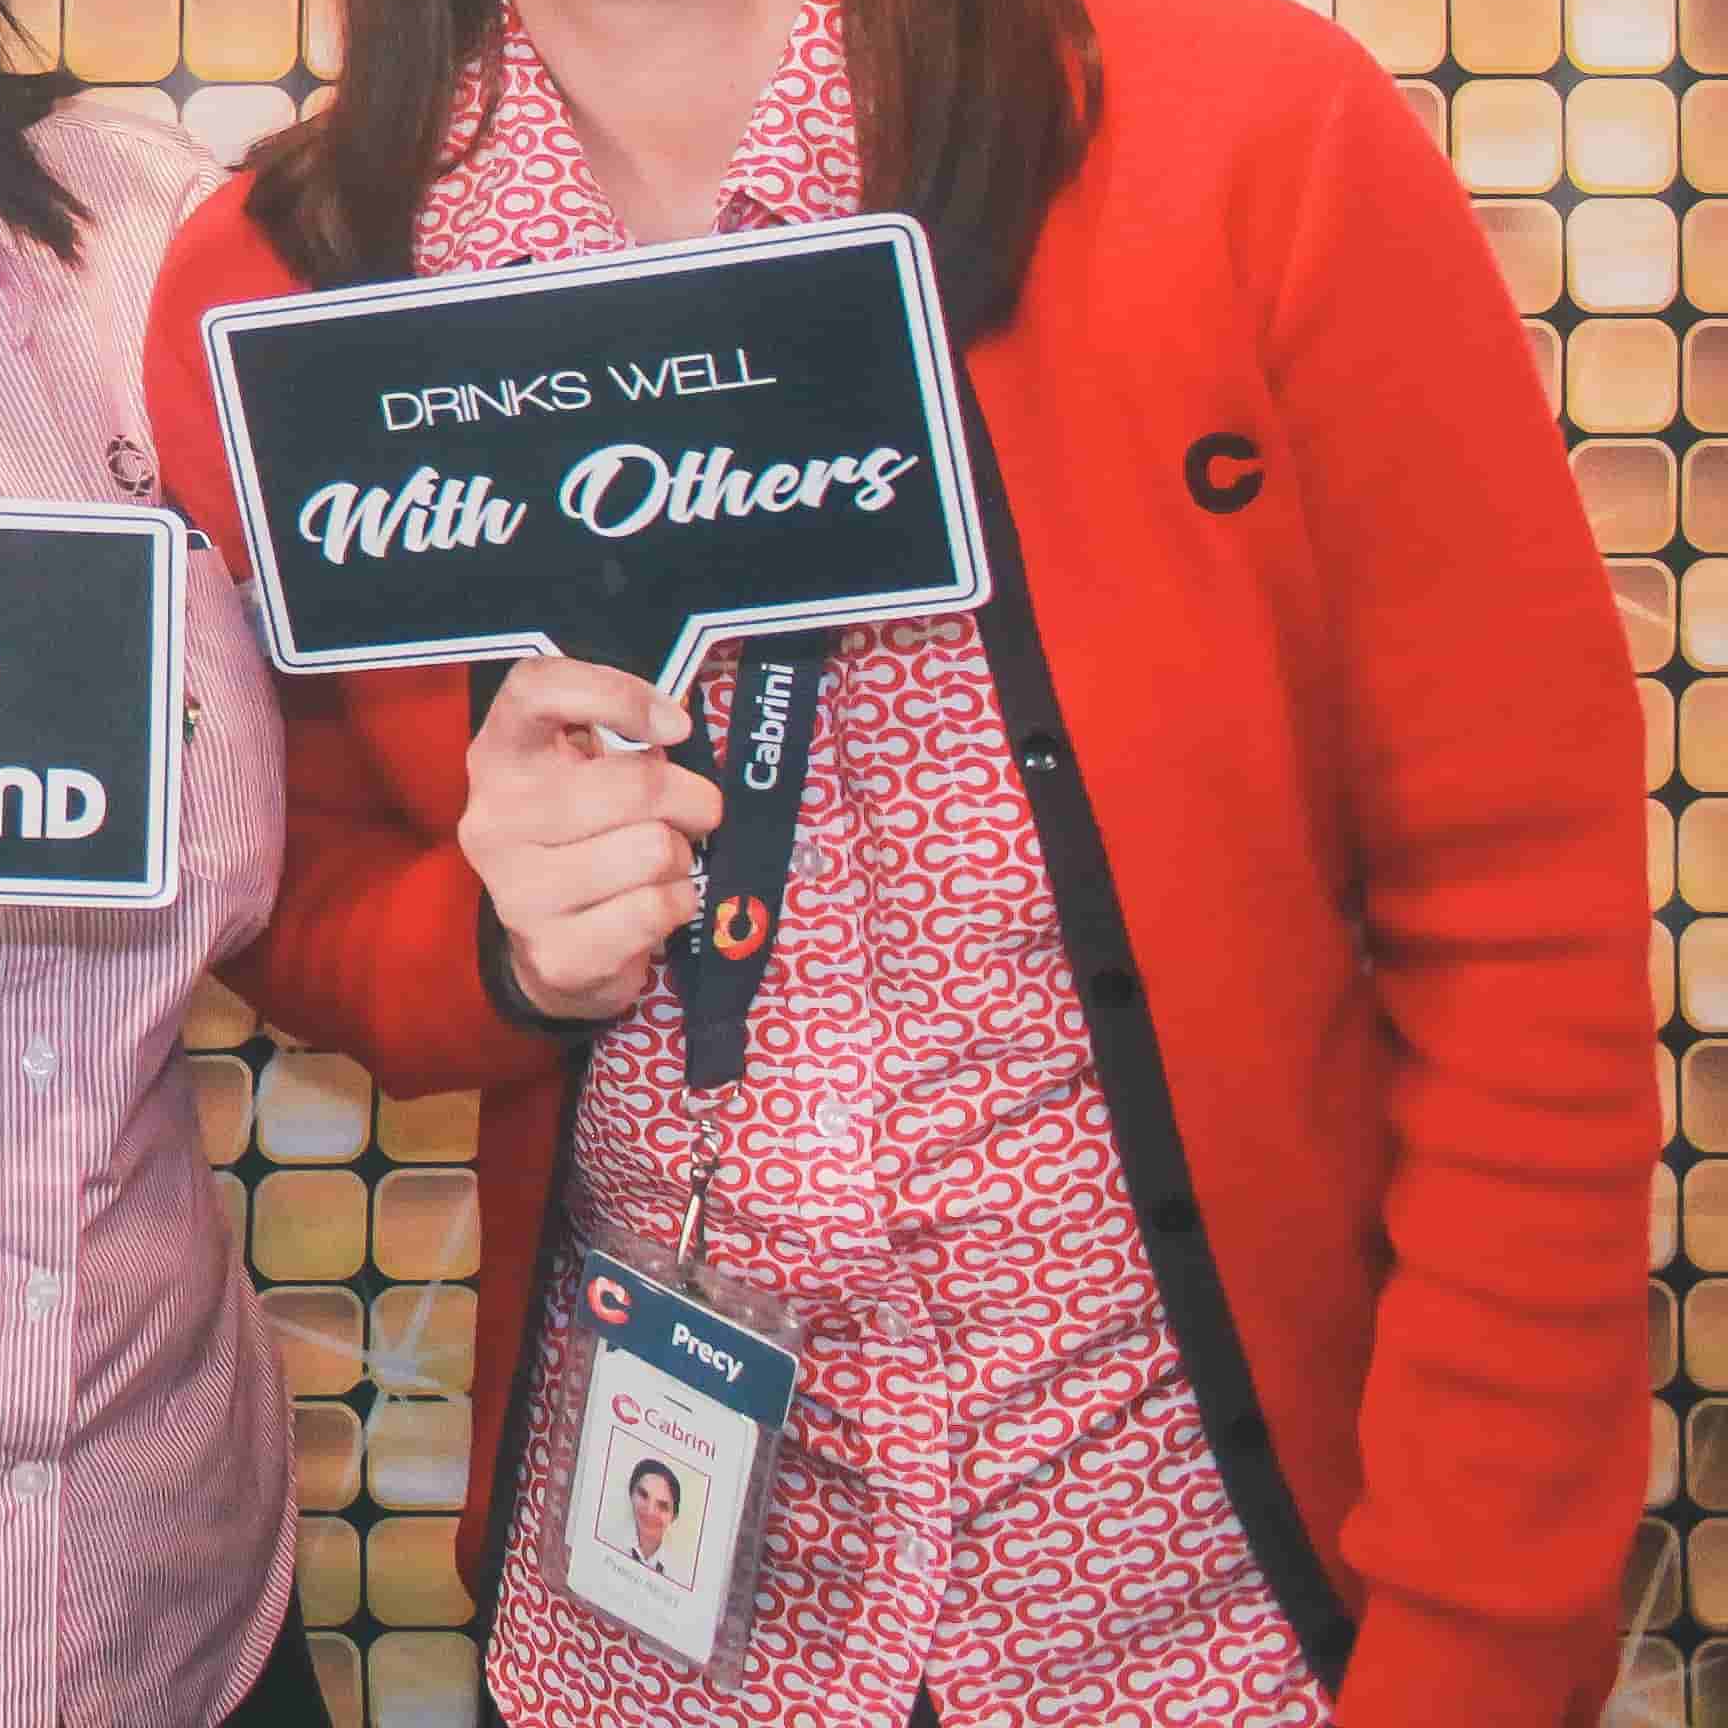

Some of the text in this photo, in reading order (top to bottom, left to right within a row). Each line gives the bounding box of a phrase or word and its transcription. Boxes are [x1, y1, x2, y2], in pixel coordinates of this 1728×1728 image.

[380, 347, 777, 432] DRINKS WELL
[297, 442, 918, 565] With Others
[744, 661, 795, 792] Cabrini
[671, 1321, 745, 1384] Precy
[643, 1407, 717, 1462] Cabrini
